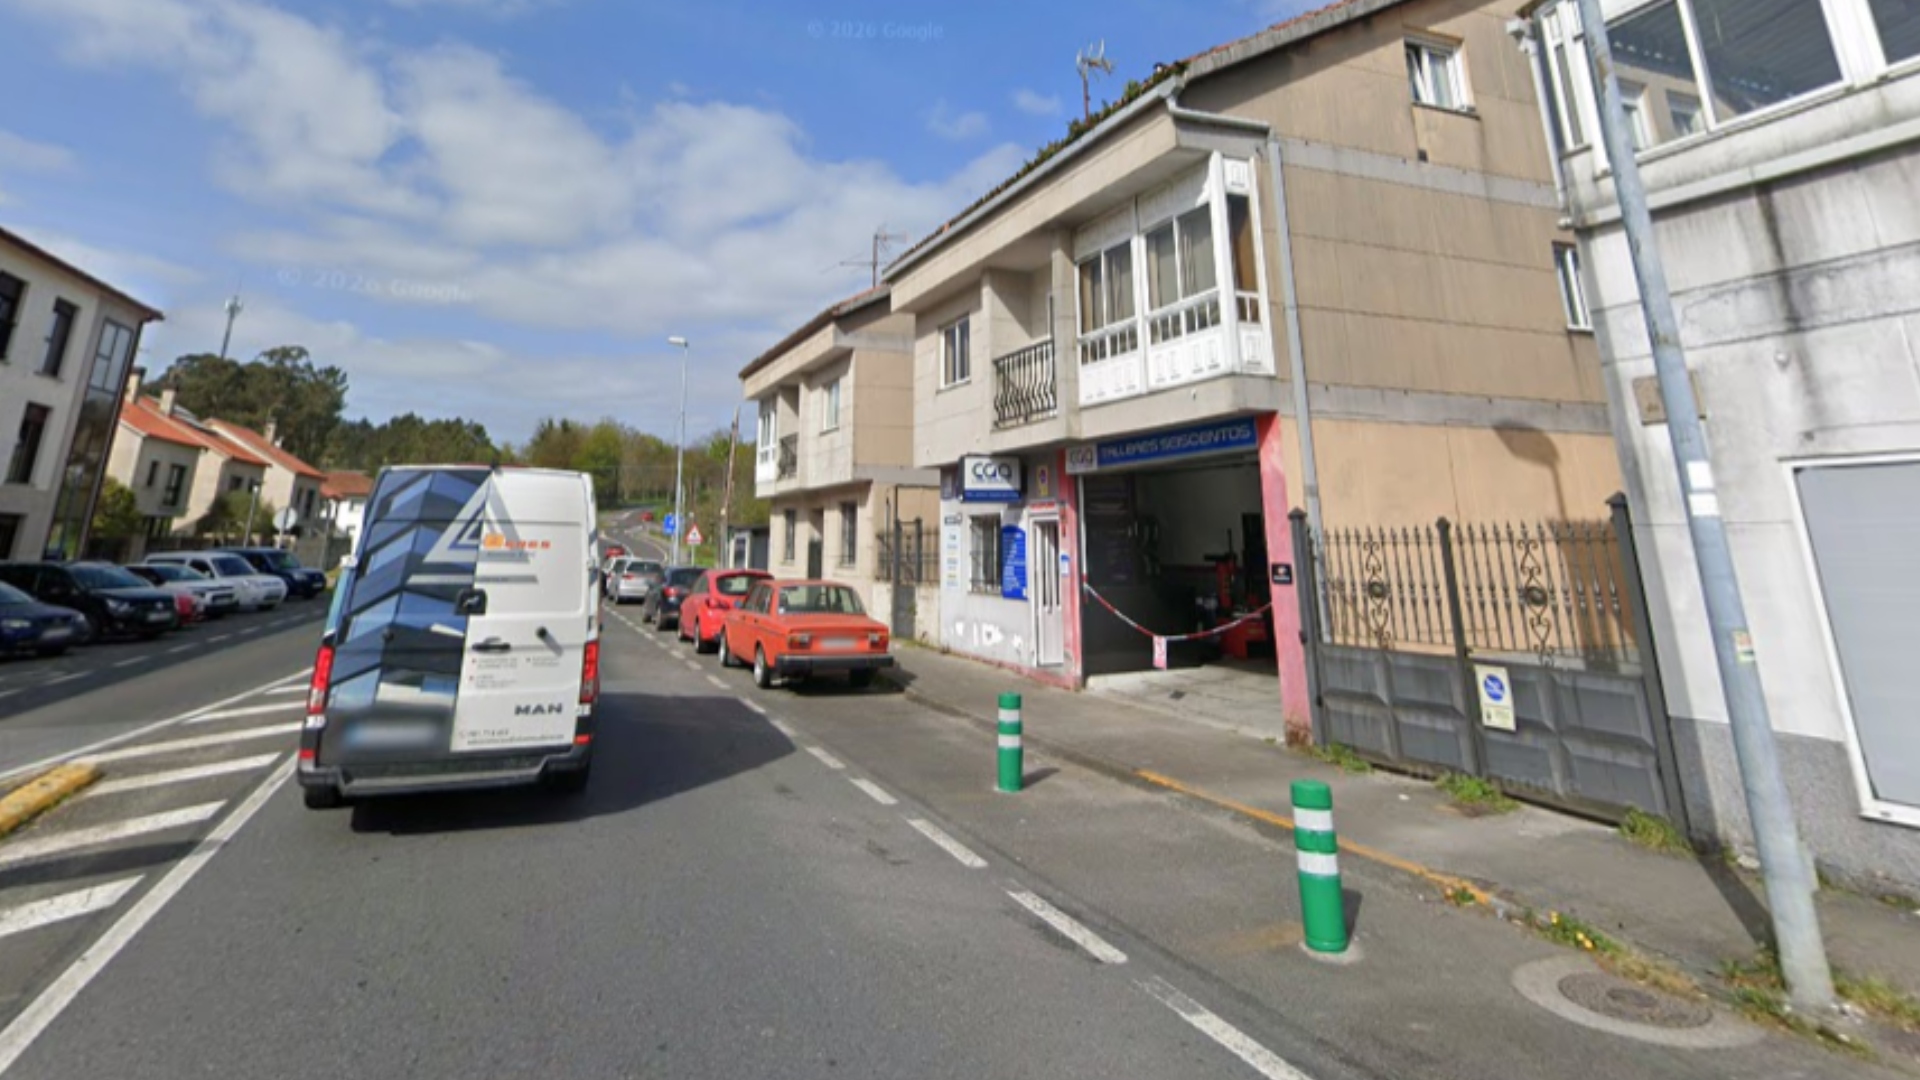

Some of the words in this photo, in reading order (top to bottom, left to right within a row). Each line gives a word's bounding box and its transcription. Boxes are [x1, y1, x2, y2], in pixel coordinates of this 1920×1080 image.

[1101, 438, 1159, 459] TALLERES
[1160, 424, 1252, 451] SEISCENTOS
[514, 702, 563, 716] MAN
